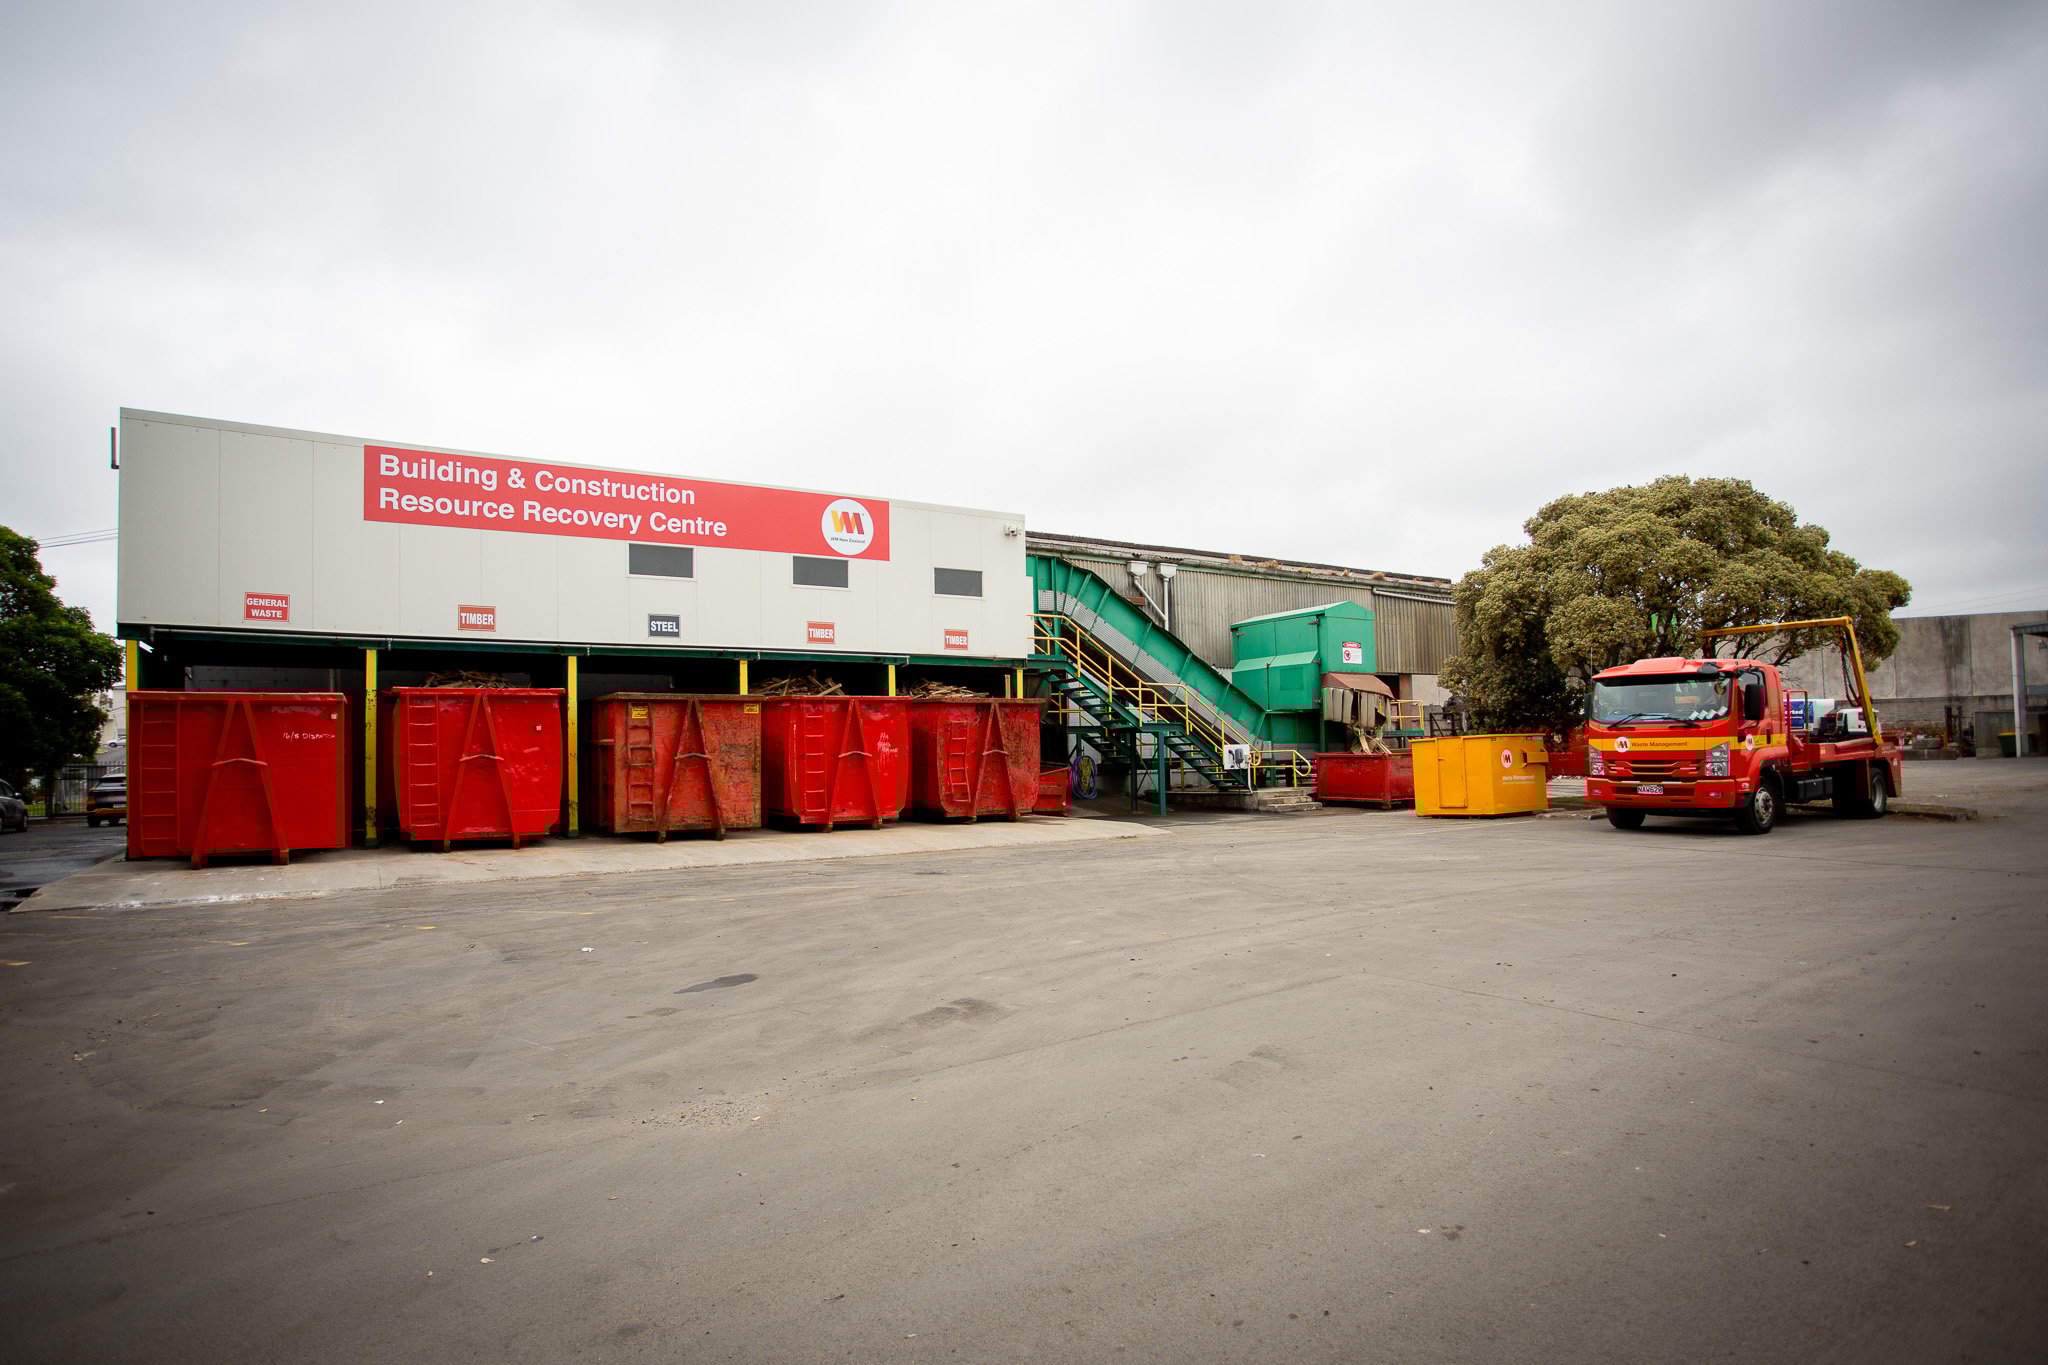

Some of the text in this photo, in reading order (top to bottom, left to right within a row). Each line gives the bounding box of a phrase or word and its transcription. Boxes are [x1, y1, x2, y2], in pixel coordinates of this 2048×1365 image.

[380, 453, 695, 505] Building & Construction
[379, 488, 727, 537] Resource Recovery Centre
[246, 597, 288, 608] GENERAL
[251, 608, 283, 618] WASTE
[460, 612, 494, 626] TIMBER
[650, 620, 679, 633] STEEL
[808, 627, 834, 639] TIMBER
[945, 635, 968, 646] TIMBER
